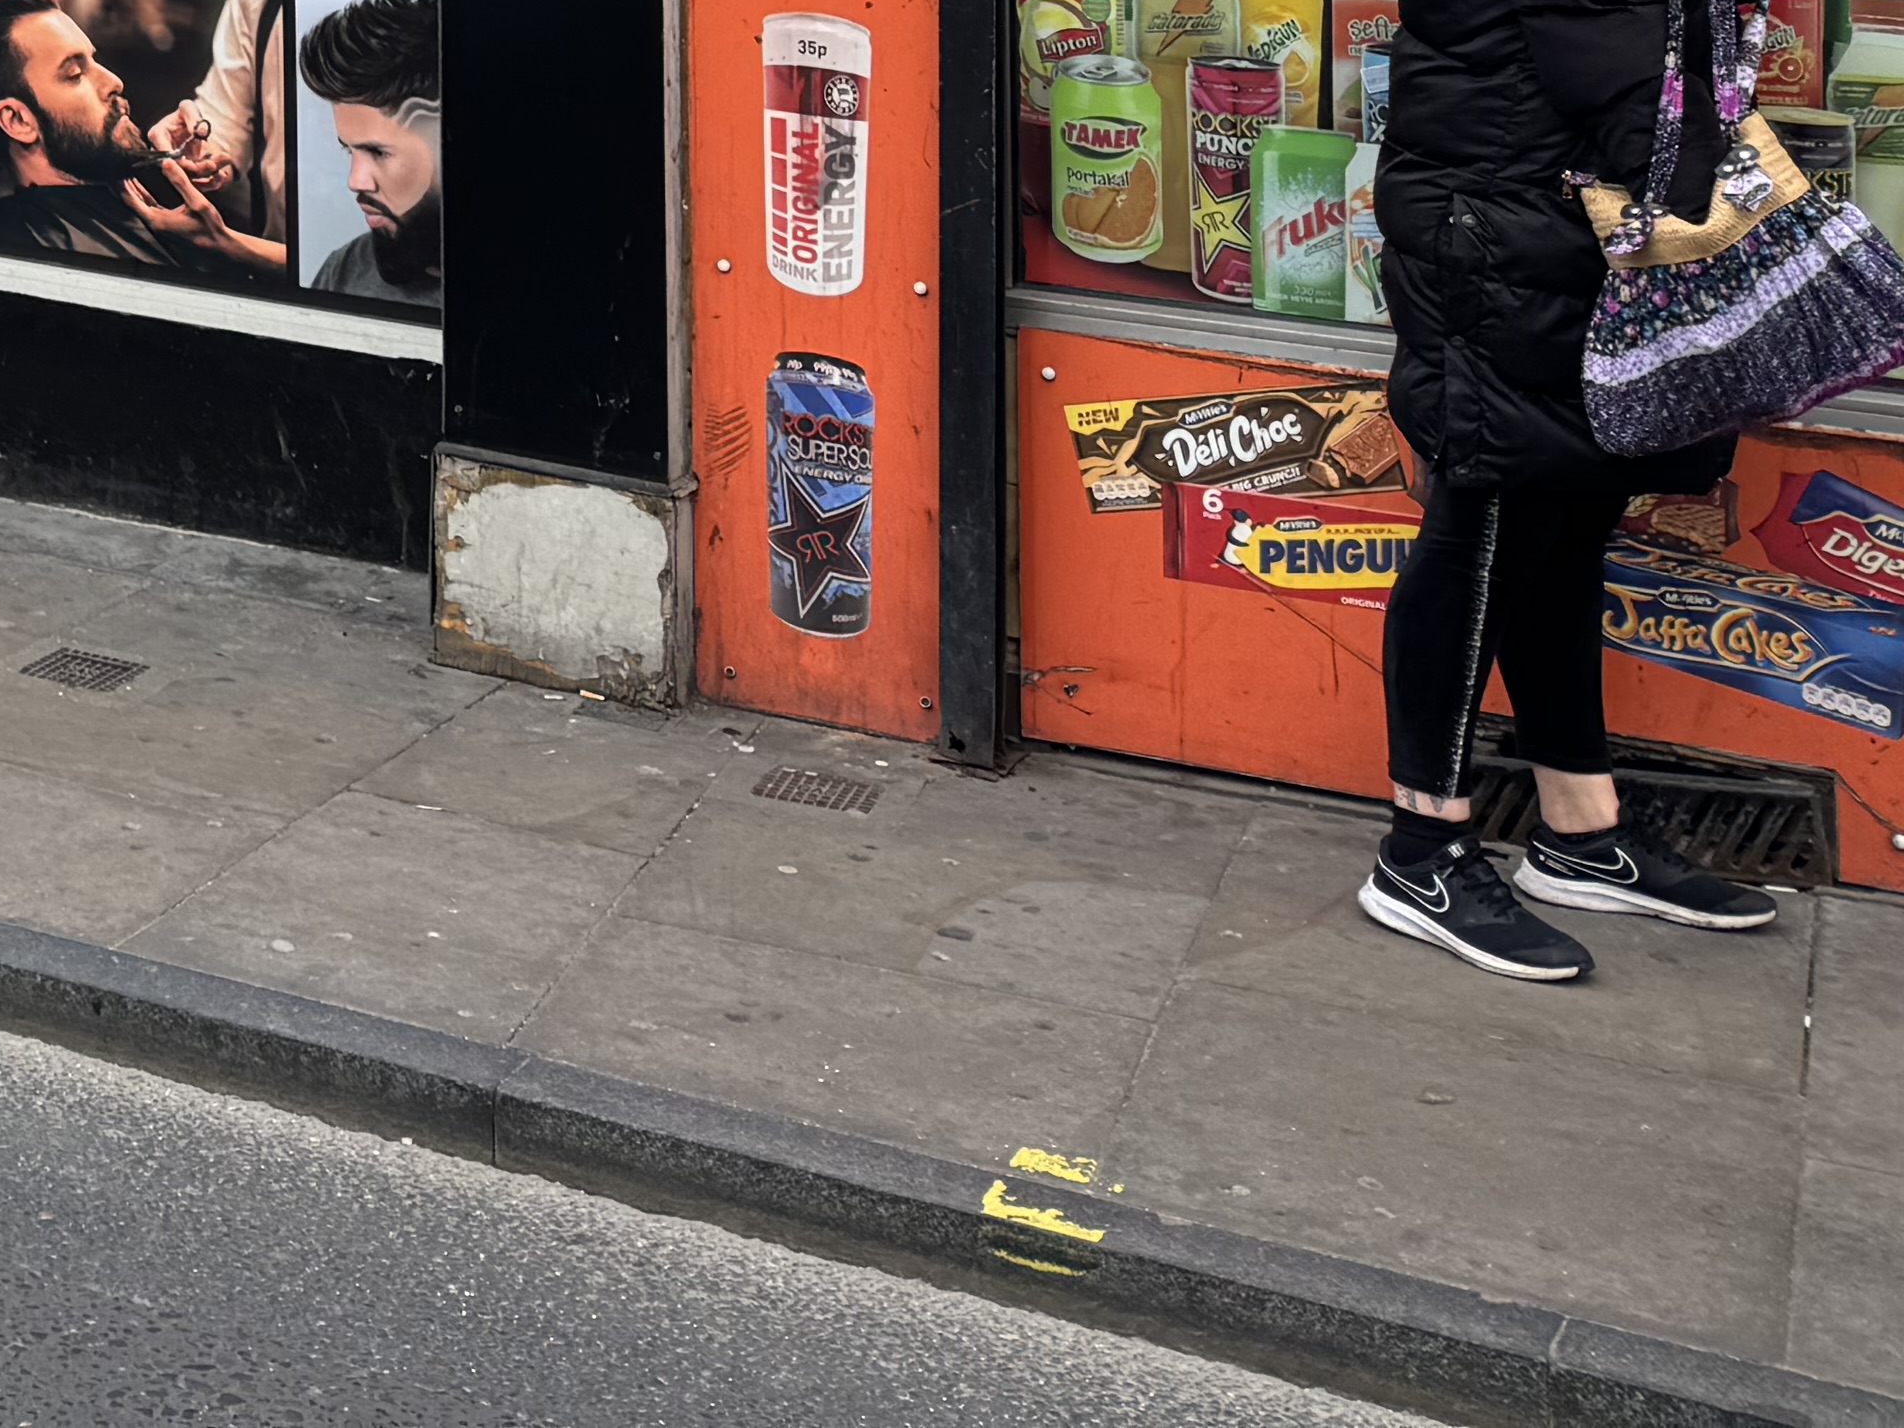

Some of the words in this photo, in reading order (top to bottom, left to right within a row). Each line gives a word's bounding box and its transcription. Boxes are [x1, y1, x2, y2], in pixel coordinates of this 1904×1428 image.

[798, 39, 828, 59] 35p
[1041, 33, 1097, 58] Lipton
[1064, 121, 1142, 149] TAMEK
[1197, 152, 1245, 171] ENERGY
[1066, 166, 1130, 188] portakal
[792, 121, 820, 265] ORIGINAL
[822, 120, 857, 284] ENERGY
[772, 253, 819, 283] DRINK
[1077, 406, 1121, 427] NEW
[1161, 427, 1228, 478] Déli
[1229, 411, 1302, 464] Choc
[794, 465, 851, 482] ENERGY
[1253, 465, 1301, 486] CRUNCH
[1203, 488, 1224, 514] 6
[1340, 595, 1387, 611] ORIGINAL
[1601, 583, 1712, 655] Jaffa
[1711, 607, 1815, 672] Cakes
